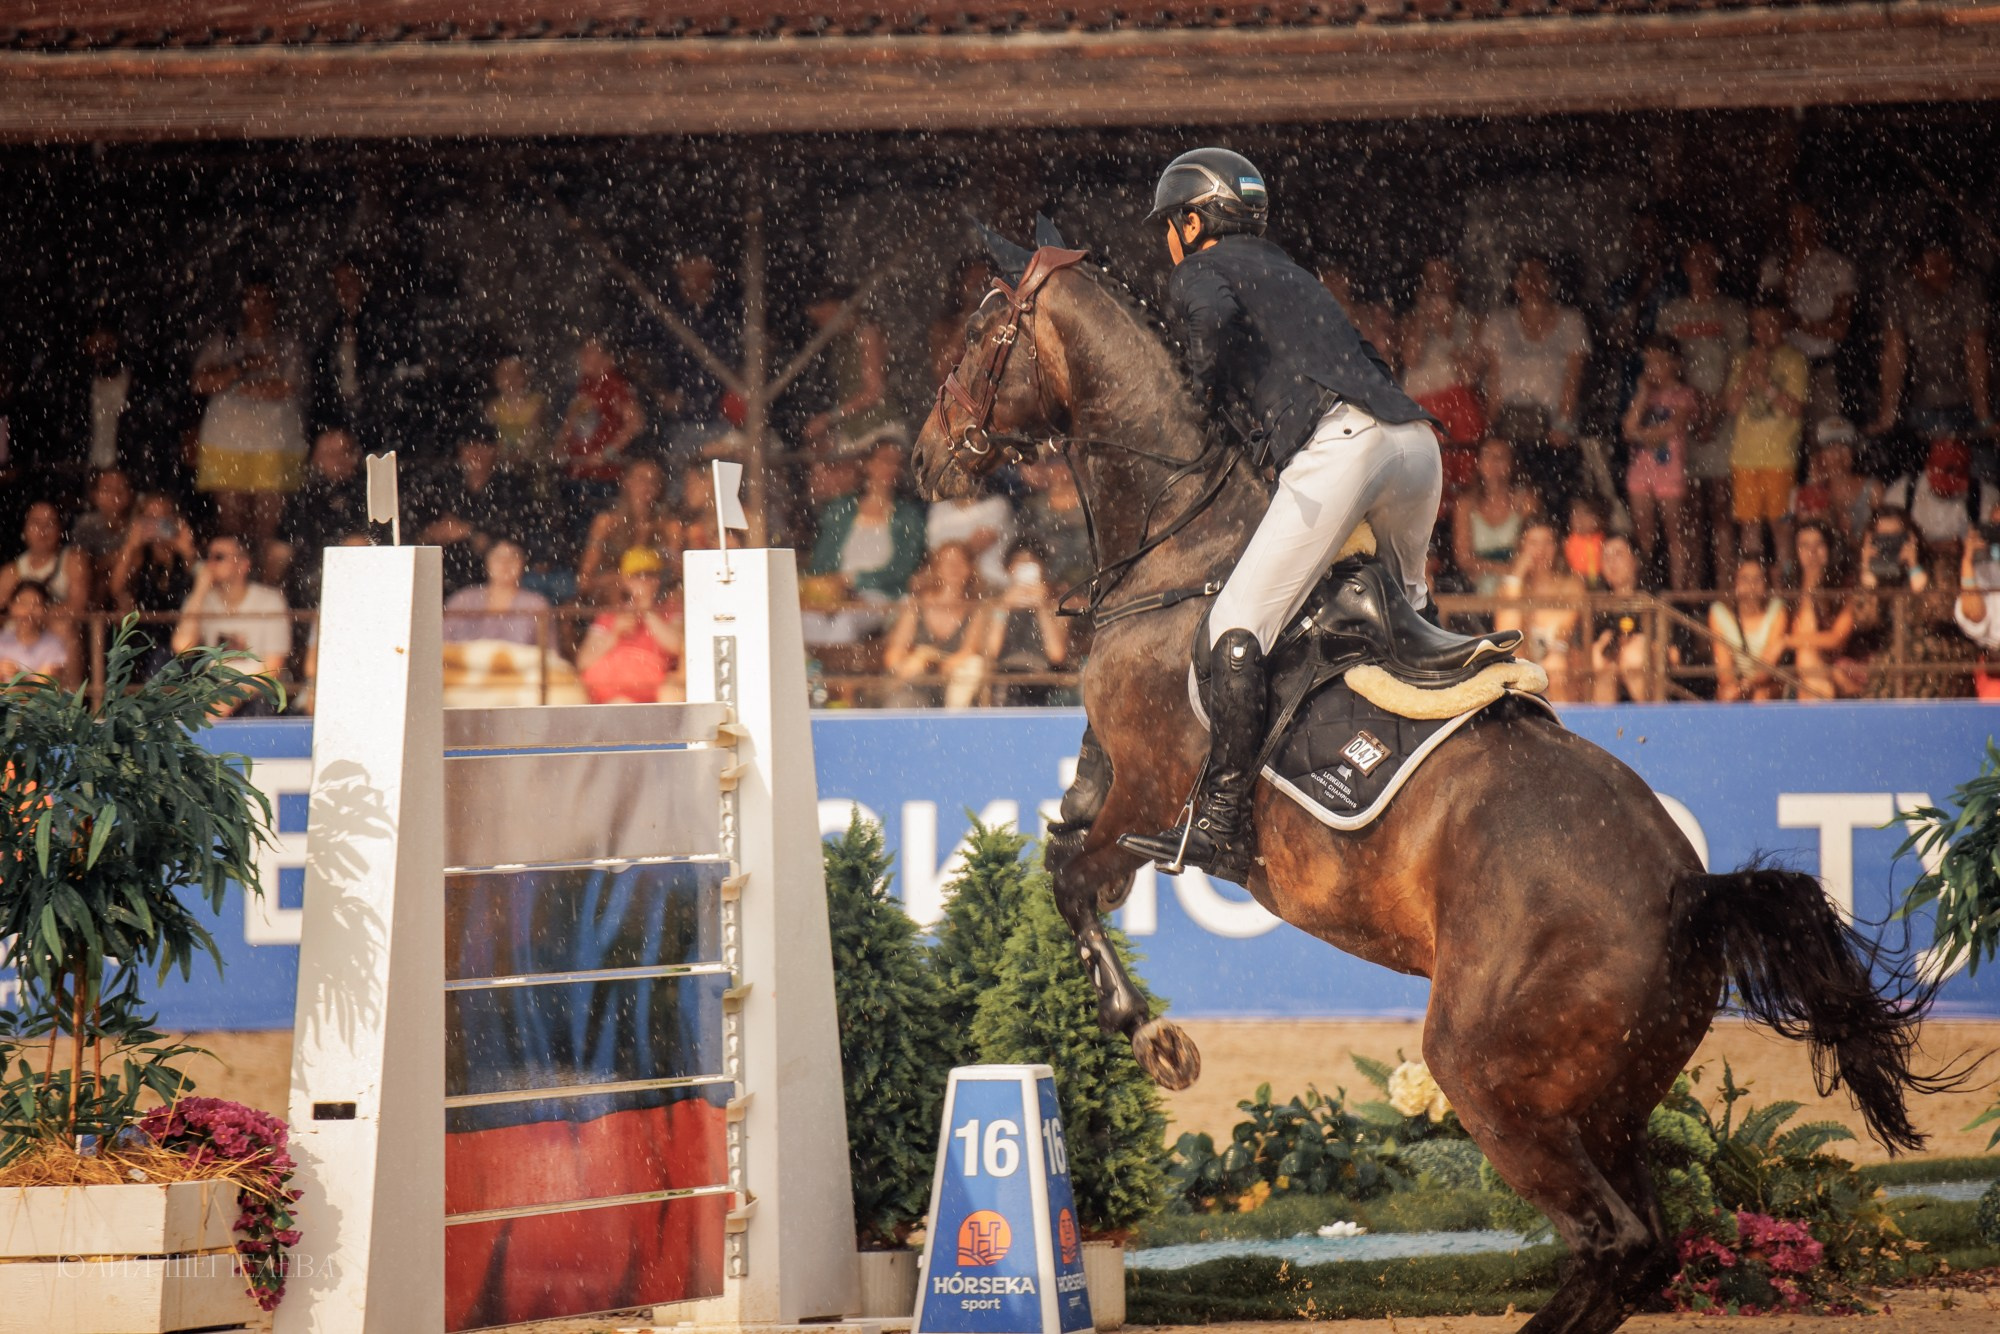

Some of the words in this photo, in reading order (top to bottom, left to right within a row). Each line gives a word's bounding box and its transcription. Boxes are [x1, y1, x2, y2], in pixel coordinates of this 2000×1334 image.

[1348, 740, 1379, 764] 047
[1310, 772, 1328, 787] GLOBAL
[1327, 784, 1358, 808] CHAMPIONS
[1323, 771, 1352, 795] LONGINES
[955, 1119, 1020, 1177] 16
[1042, 1116, 1067, 1175] 16
[933, 1271, 1036, 1295] HÓRSEKA
[961, 1297, 1001, 1313] sport
